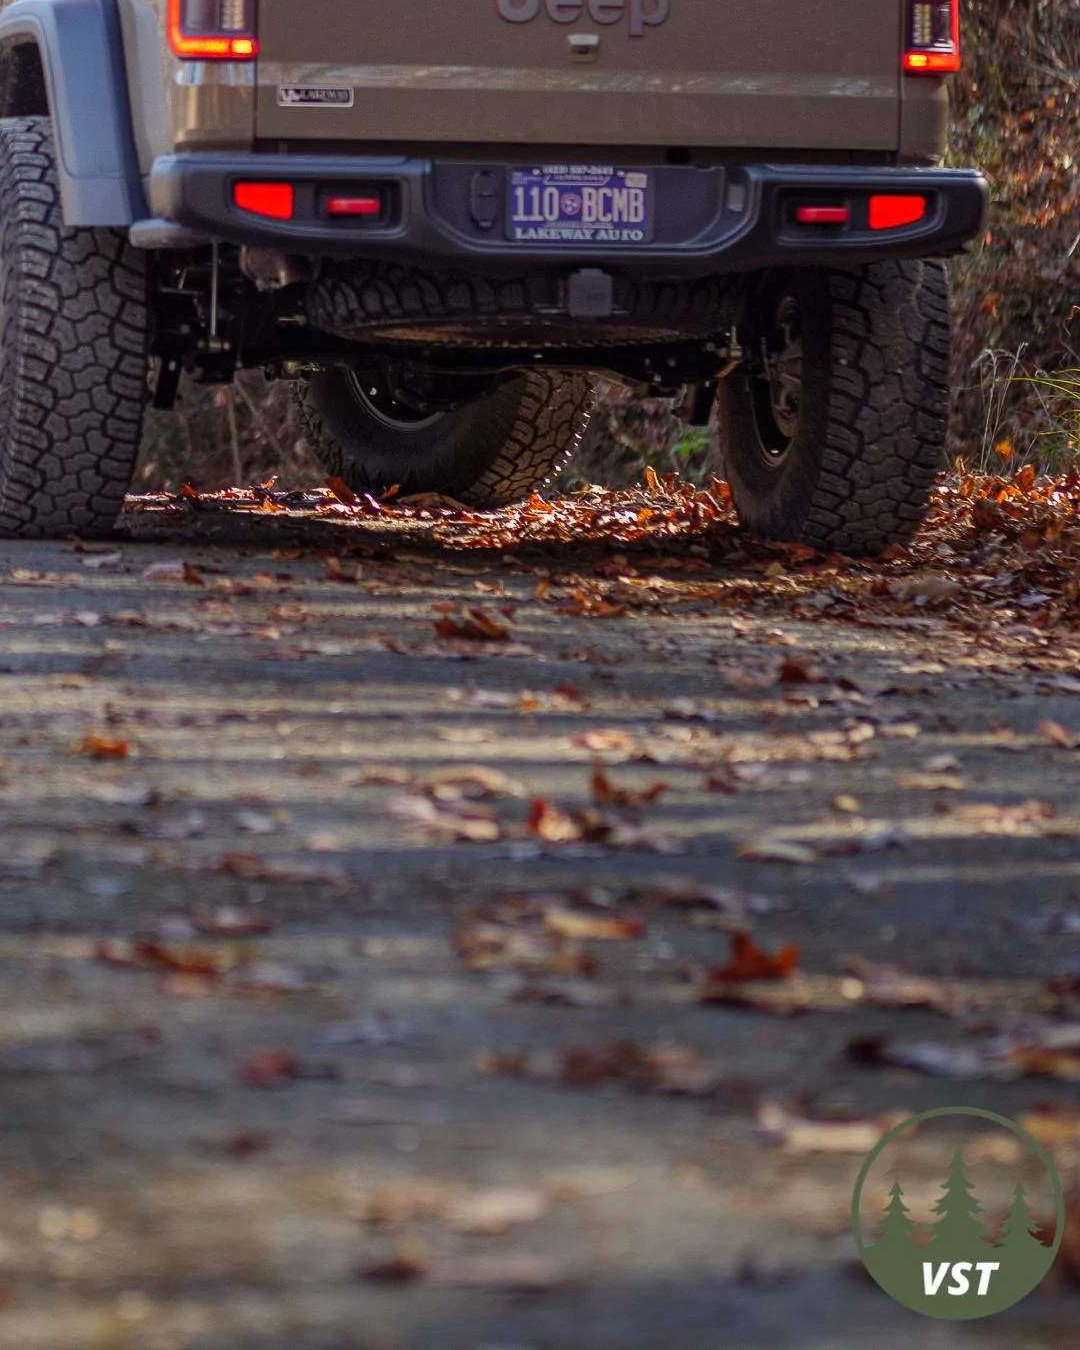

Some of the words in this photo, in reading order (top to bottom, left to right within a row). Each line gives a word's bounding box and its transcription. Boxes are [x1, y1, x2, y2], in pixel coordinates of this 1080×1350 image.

[512, 186, 559, 222] 110
[582, 187, 645, 223] BCMB
[515, 227, 595, 240] LAKEWAY
[596, 229, 644, 241] AUTO
